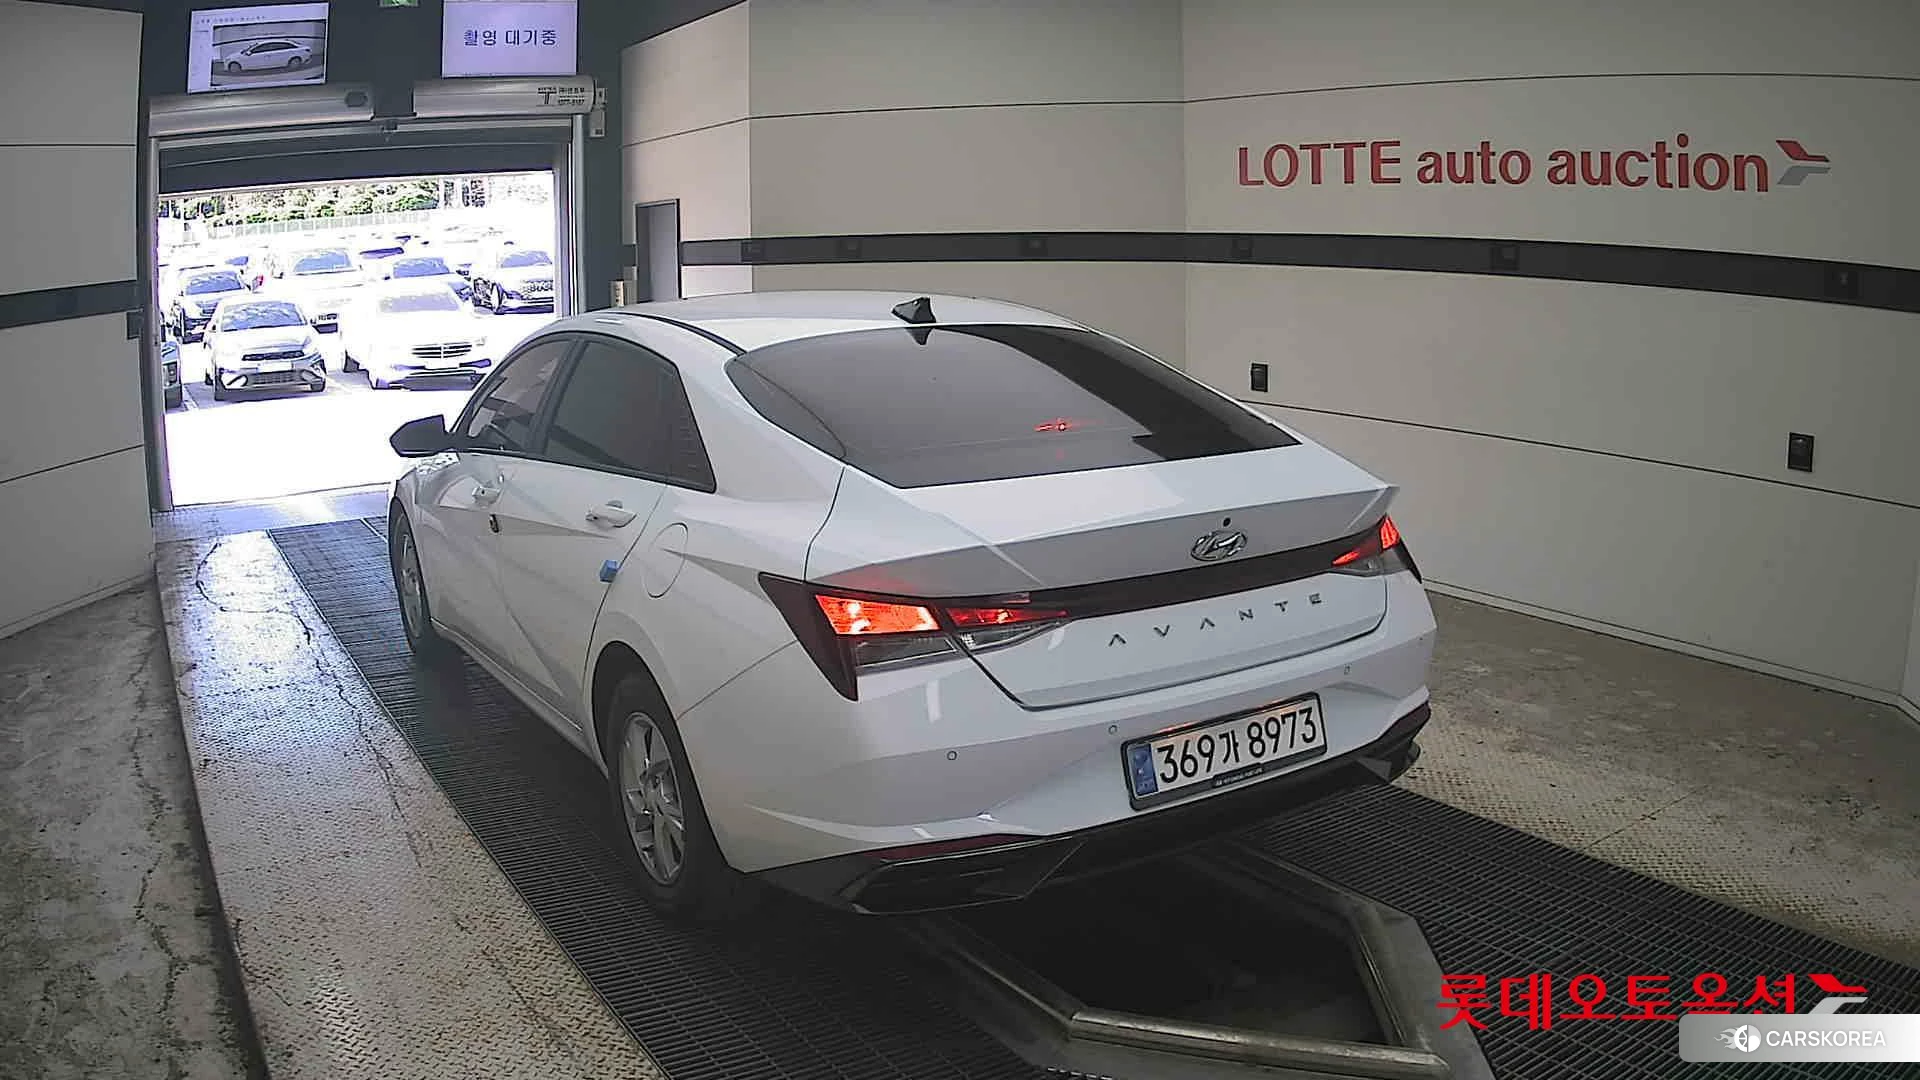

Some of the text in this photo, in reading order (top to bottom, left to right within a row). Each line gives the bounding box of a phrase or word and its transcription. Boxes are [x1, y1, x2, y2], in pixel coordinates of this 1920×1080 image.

[505, 29, 557, 46] 대기중
[1238, 133, 1769, 193] LOTTE auto auction
[1107, 592, 1323, 648] AVANTE
[1156, 707, 1317, 784] 369가 8973
